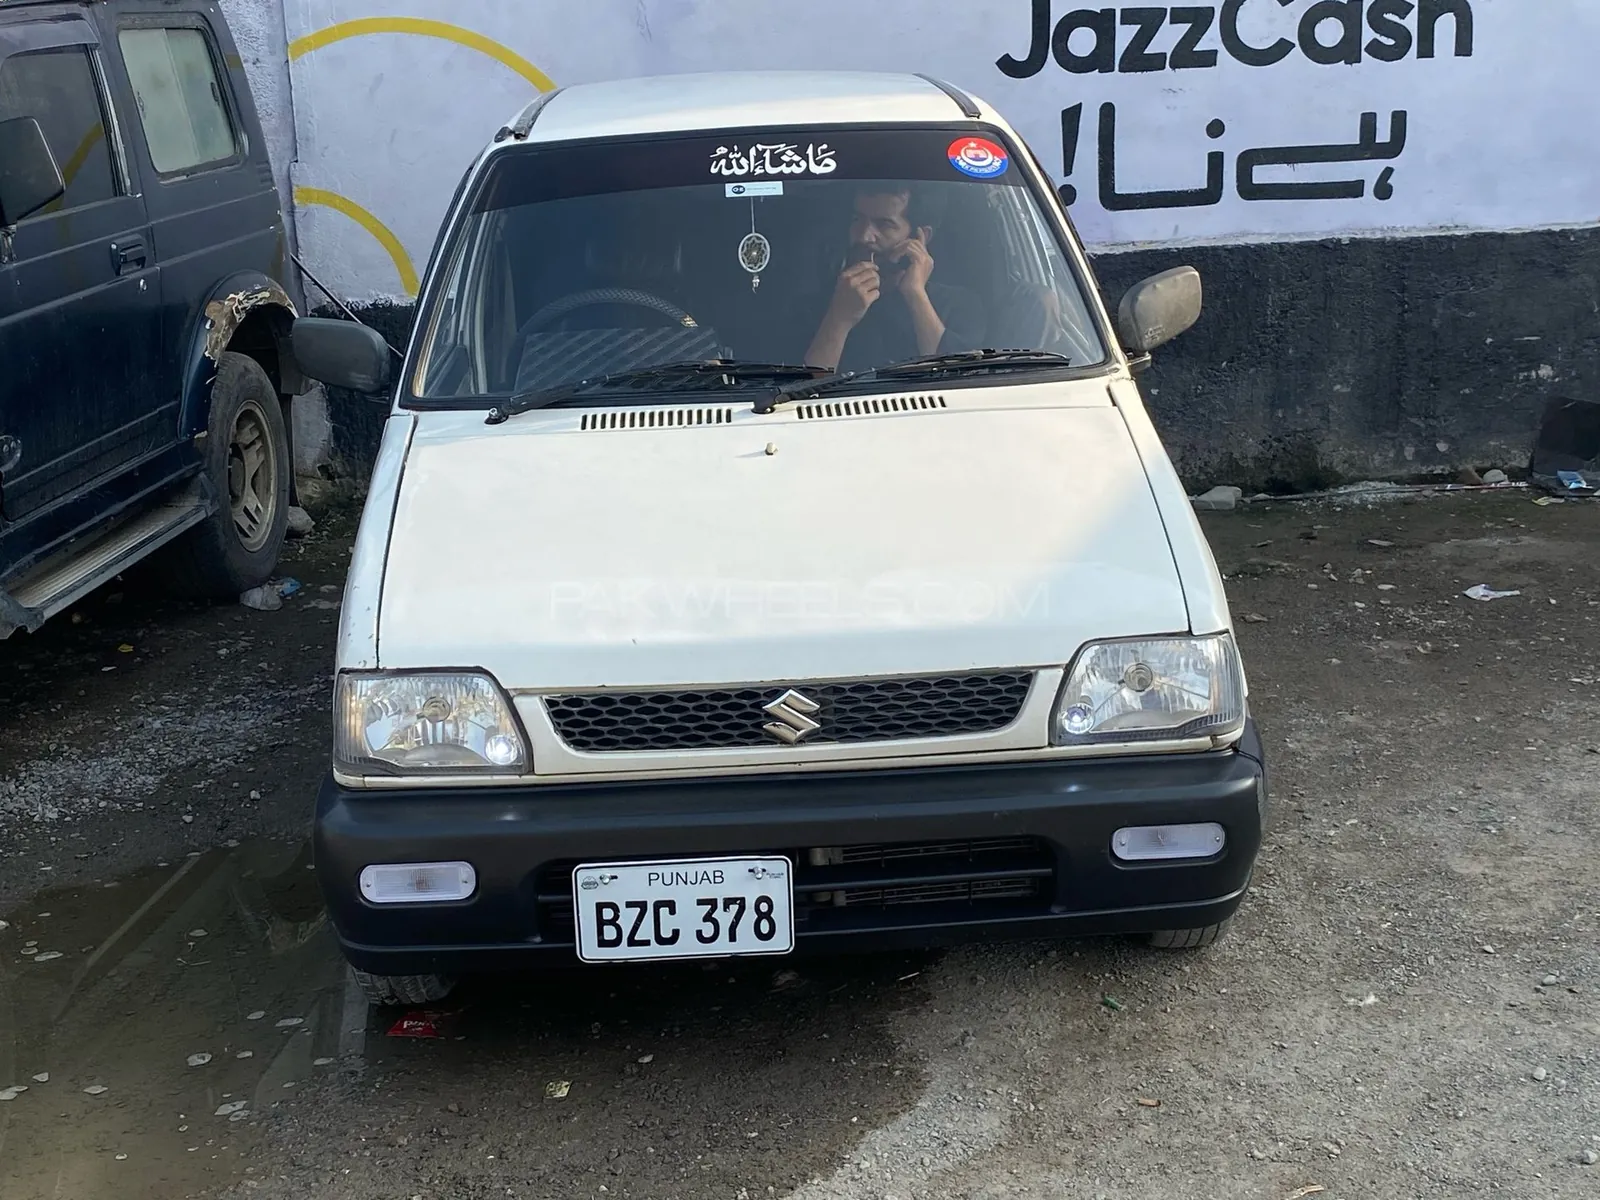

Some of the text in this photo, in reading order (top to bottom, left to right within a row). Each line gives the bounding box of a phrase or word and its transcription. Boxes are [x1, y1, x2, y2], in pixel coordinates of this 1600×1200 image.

[995, 0, 1474, 79] JazzCash
[649, 870, 724, 887] PUNJAB
[595, 895, 776, 948] BZC 378
